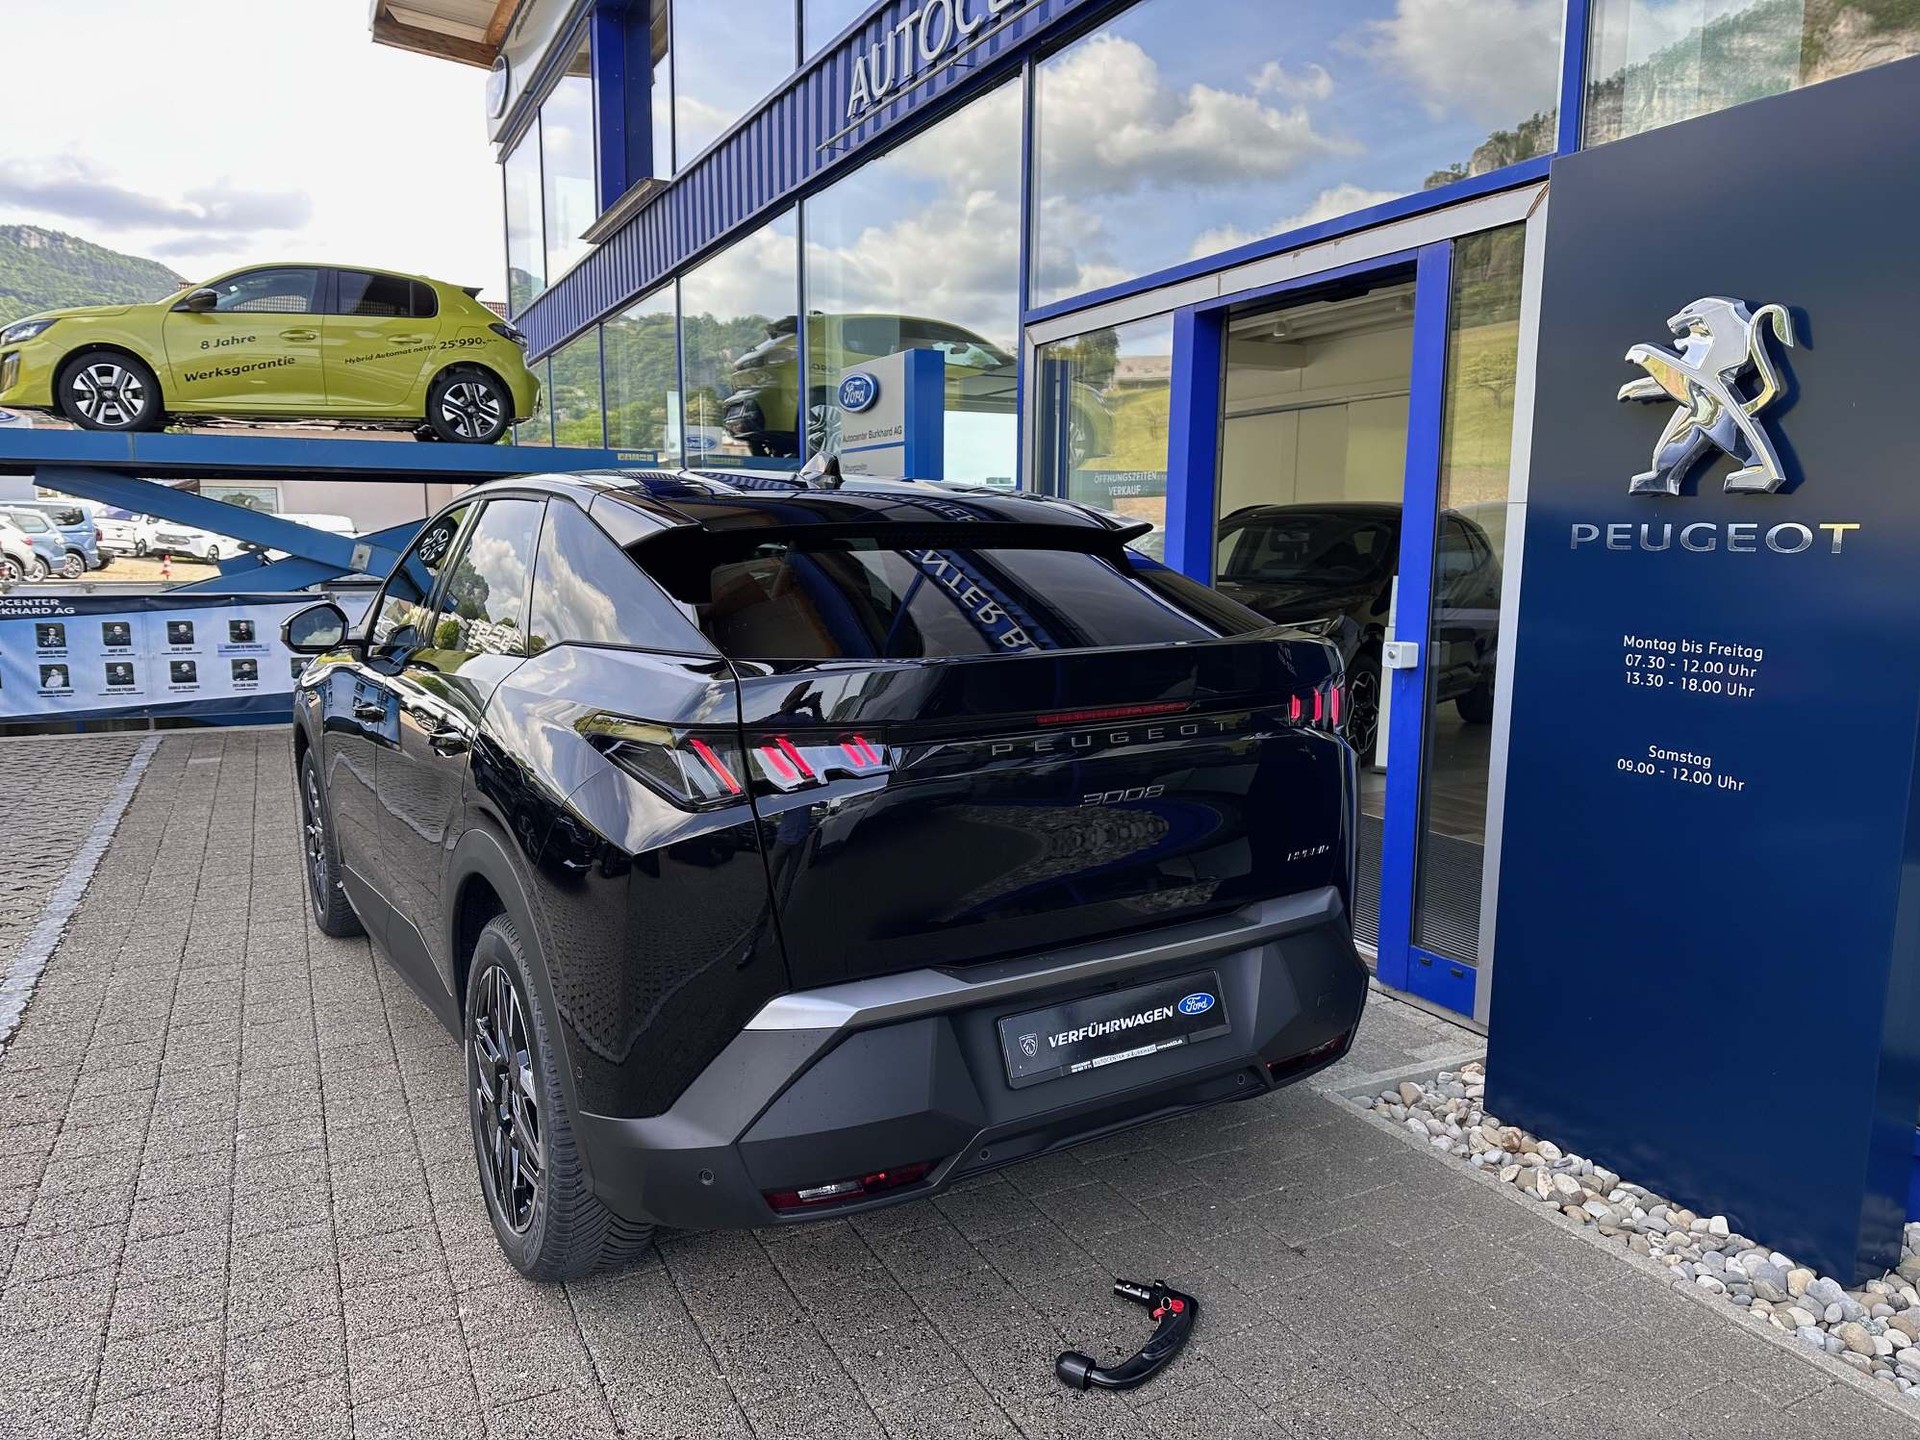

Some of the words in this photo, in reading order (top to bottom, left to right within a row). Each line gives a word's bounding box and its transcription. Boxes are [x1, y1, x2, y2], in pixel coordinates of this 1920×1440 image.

[847, 0, 1014, 118] AUTOC
[200, 340, 210, 350] 8
[213, 335, 257, 349] Jahre
[184, 355, 296, 382] Werksgarantie
[344, 354, 374, 365] Hybrid
[375, 348, 412, 360] Automat
[868, 427, 893, 440] Burkhard
[894, 425, 903, 437] AG
[1094, 471, 1157, 484] ÖFFNUNGSZEITEN
[1108, 485, 1142, 496] VERKAUF
[1570, 522, 1861, 554] PEUGEOT
[0, 607, 52, 615] KHARD
[54, 607, 76, 615] AG
[1623, 635, 1677, 654] Montag
[1682, 639, 1703, 654] bis
[1708, 642, 1763, 662] Freitag
[1625, 653, 1666, 669] 07.30
[1682, 659, 1724, 675] 12.00
[1728, 663, 1757, 678] Uhr
[1625, 671, 1664, 687] 13.30
[1681, 677, 1722, 694] 18.00
[1727, 683, 1755, 698] Uhr
[992, 721, 1226, 756] PEUGEOT
[1648, 745, 1712, 769] Samstag
[1617, 758, 1655, 775] 09.00
[1672, 767, 1712, 785] 12.00
[1717, 774, 1745, 791] Uhr
[1080, 785, 1165, 808] 3008
[1048, 1005, 1173, 1048] VERFÜHRWAGEN
